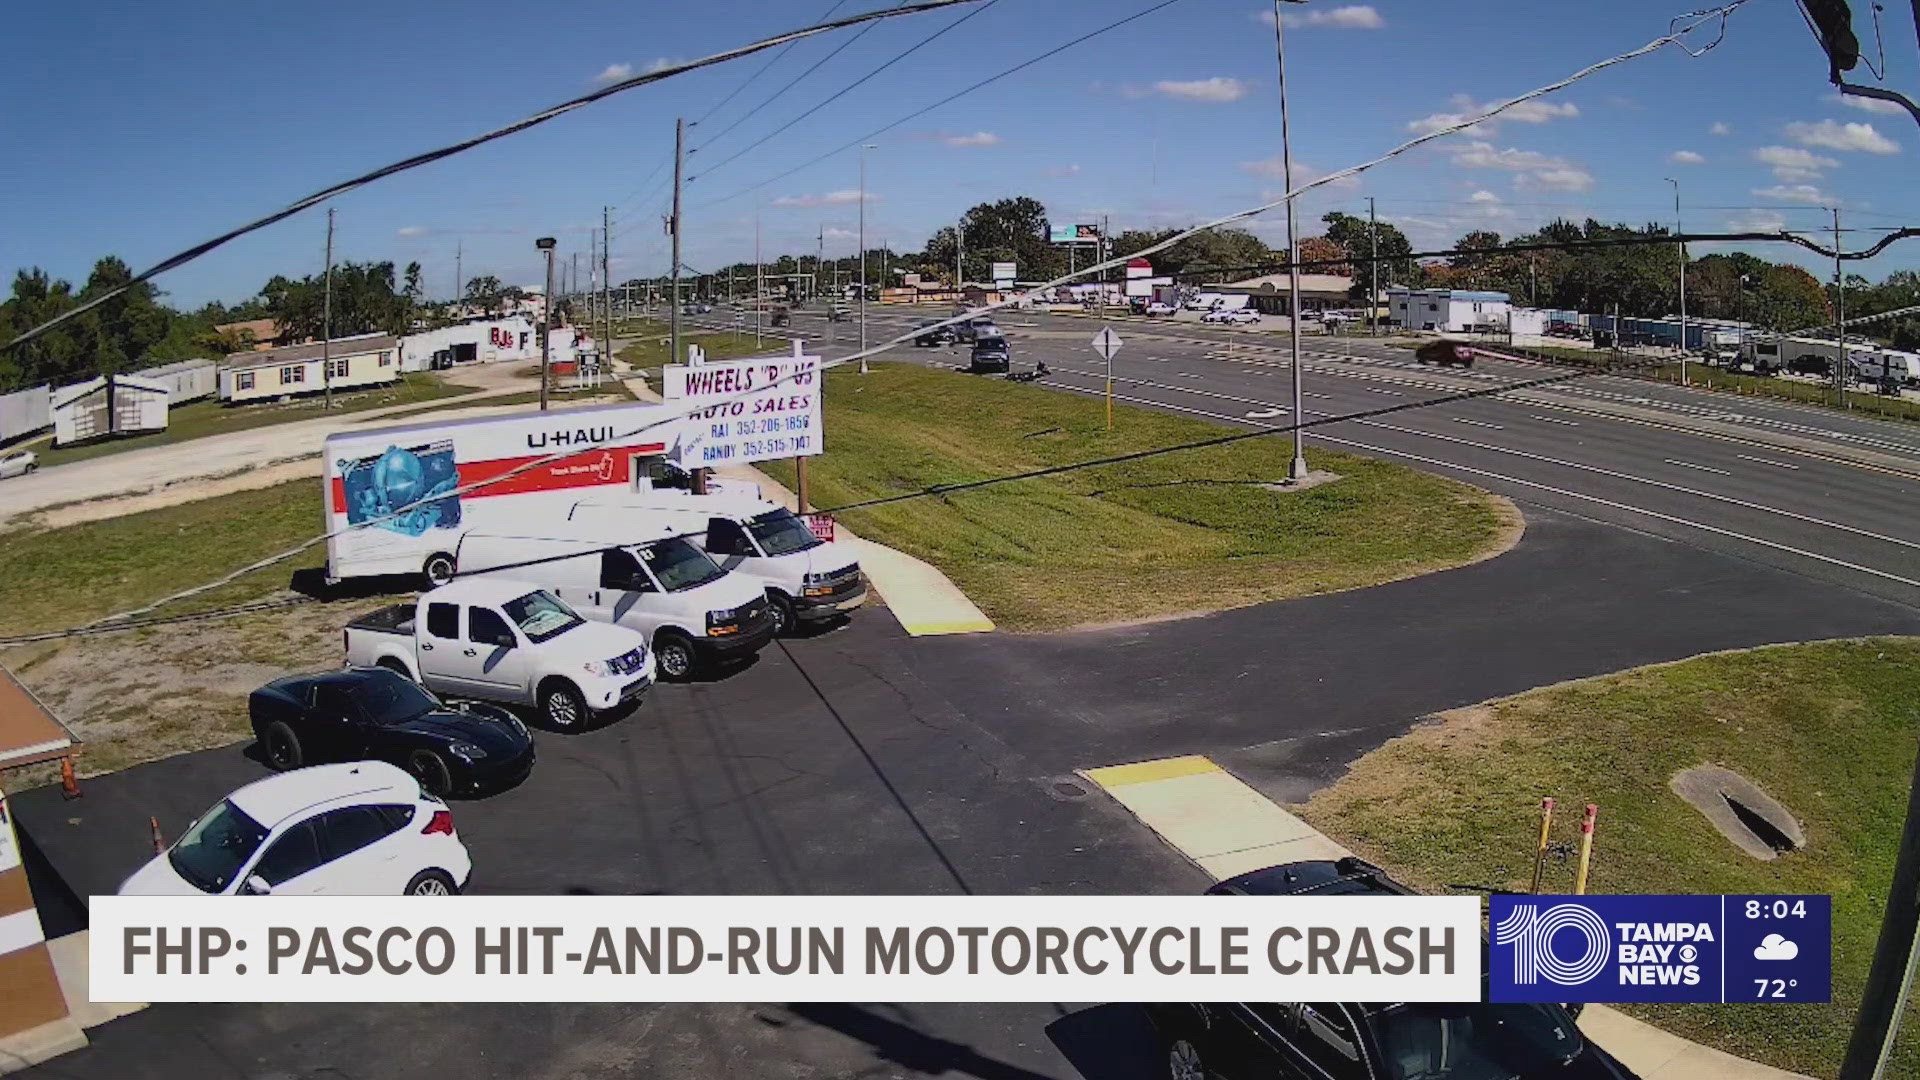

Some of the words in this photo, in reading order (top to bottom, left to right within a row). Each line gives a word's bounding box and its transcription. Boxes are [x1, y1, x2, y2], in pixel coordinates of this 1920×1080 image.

[686, 367, 754, 396] WHEELS
[794, 362, 815, 385] US
[689, 402, 744, 420] AUTO
[753, 395, 812, 414] SALES
[711, 423, 729, 438] RAI
[703, 444, 736, 461] RANDY
